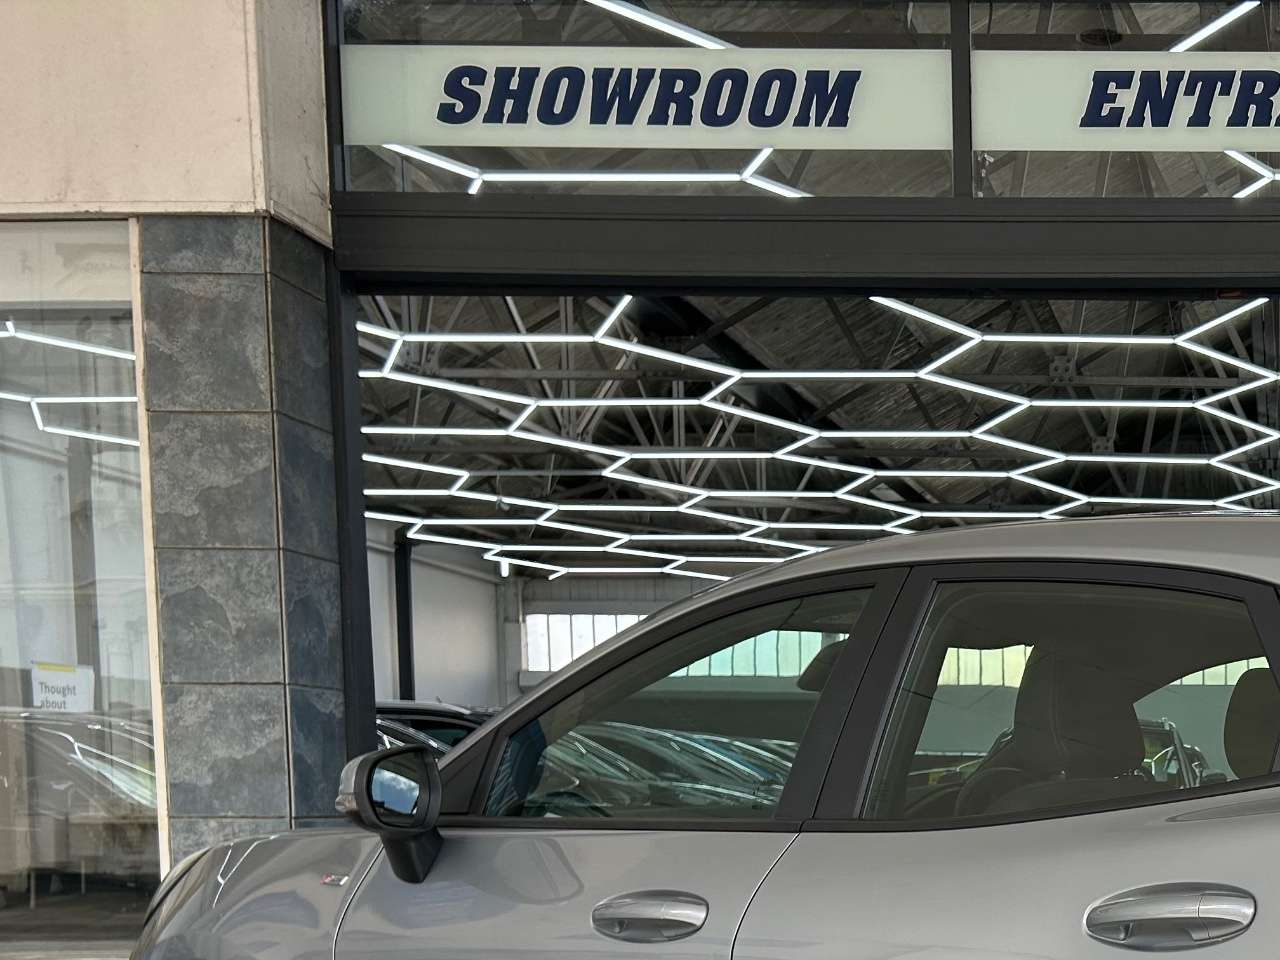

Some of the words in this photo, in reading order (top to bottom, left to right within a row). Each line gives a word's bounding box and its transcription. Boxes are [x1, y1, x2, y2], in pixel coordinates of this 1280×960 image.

[435, 65, 862, 128] SHOWROOM
[38, 681, 77, 698] Thought
[40, 699, 67, 710] about
